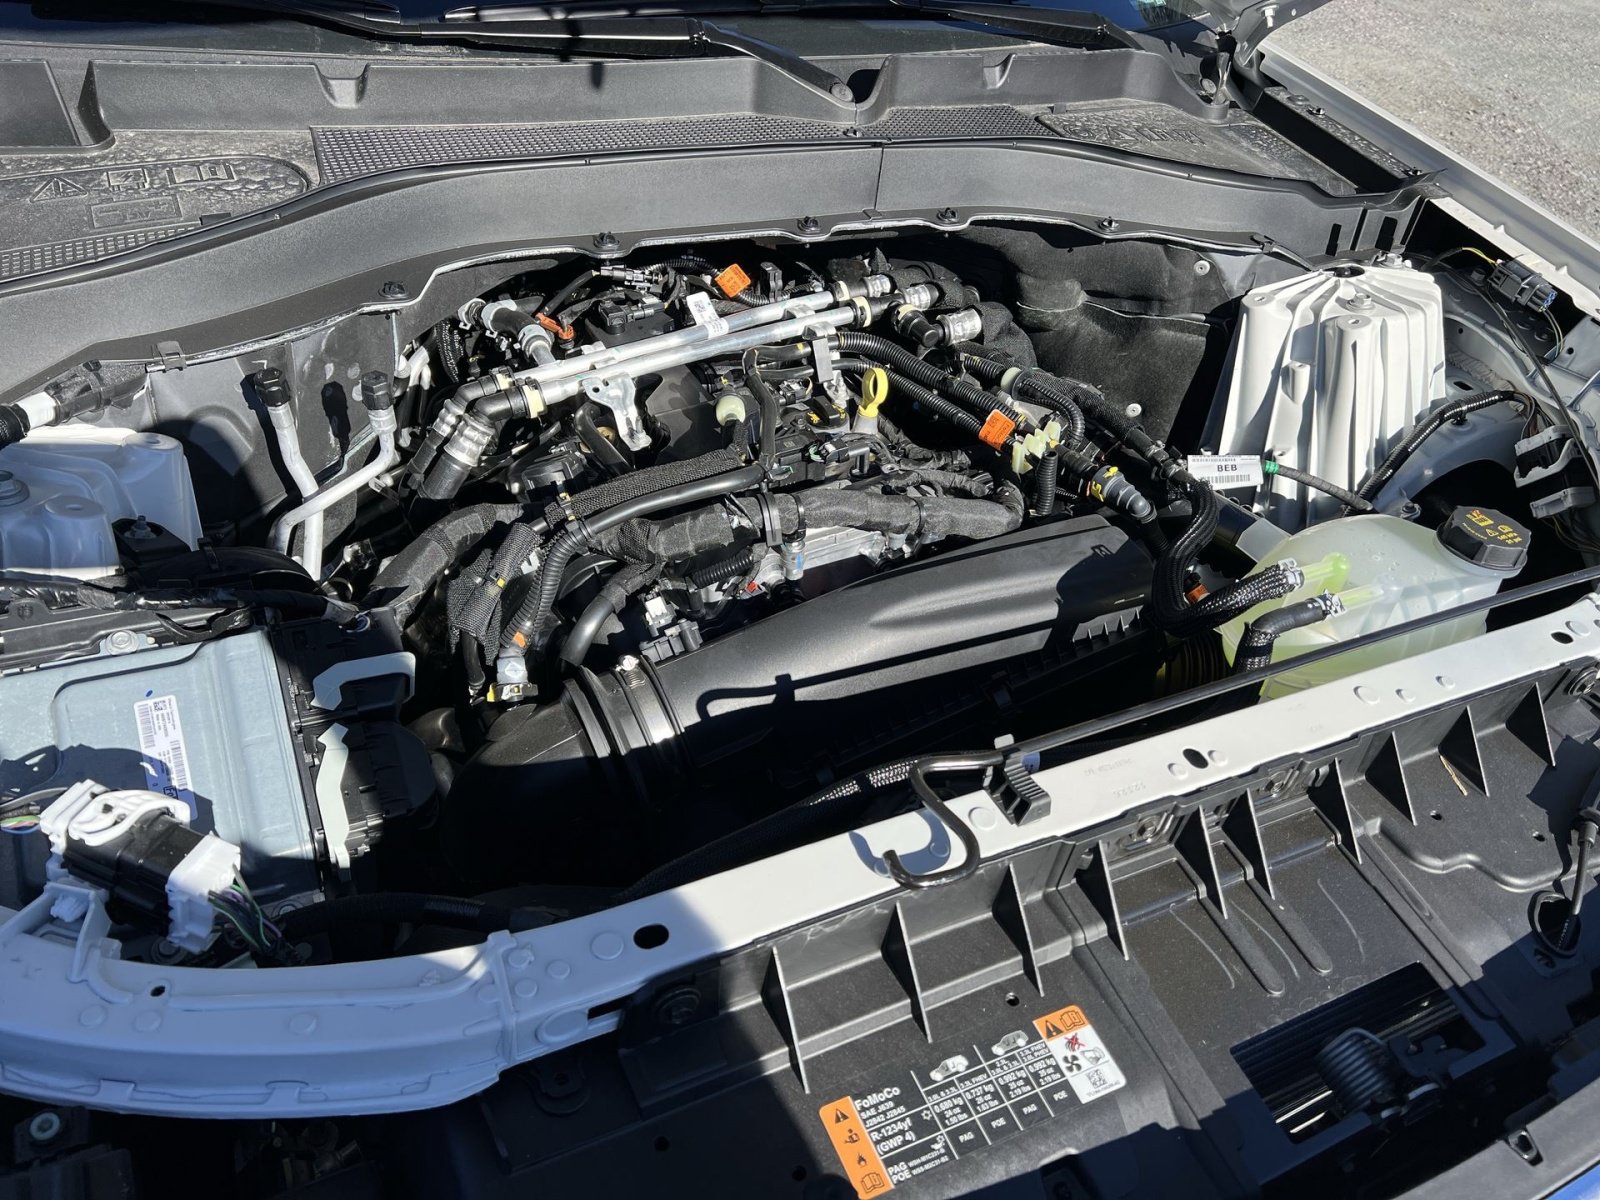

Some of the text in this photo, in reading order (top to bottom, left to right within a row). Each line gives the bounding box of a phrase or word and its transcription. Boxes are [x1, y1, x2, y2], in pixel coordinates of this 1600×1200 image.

[1217, 464, 1238, 473] BEB
[1045, 1057, 1056, 1066] kg
[1015, 1069, 1027, 1078] kg
[965, 1084, 995, 1100] 0.737 kg
[1053, 1090, 1068, 1101] POE
[855, 1087, 900, 1111] FoMoCo
[952, 1097, 964, 1106] kg
[860, 1107, 877, 1119] SAE
[1022, 1103, 1038, 1115] PAG
[991, 1117, 1006, 1129] POE
[870, 1117, 912, 1142] R-1234yf
[877, 1131, 916, 1155] (GWP 4)
[959, 1132, 975, 1143] PAG
[888, 1162, 908, 1175] PAG
[892, 1170, 912, 1184] POE
